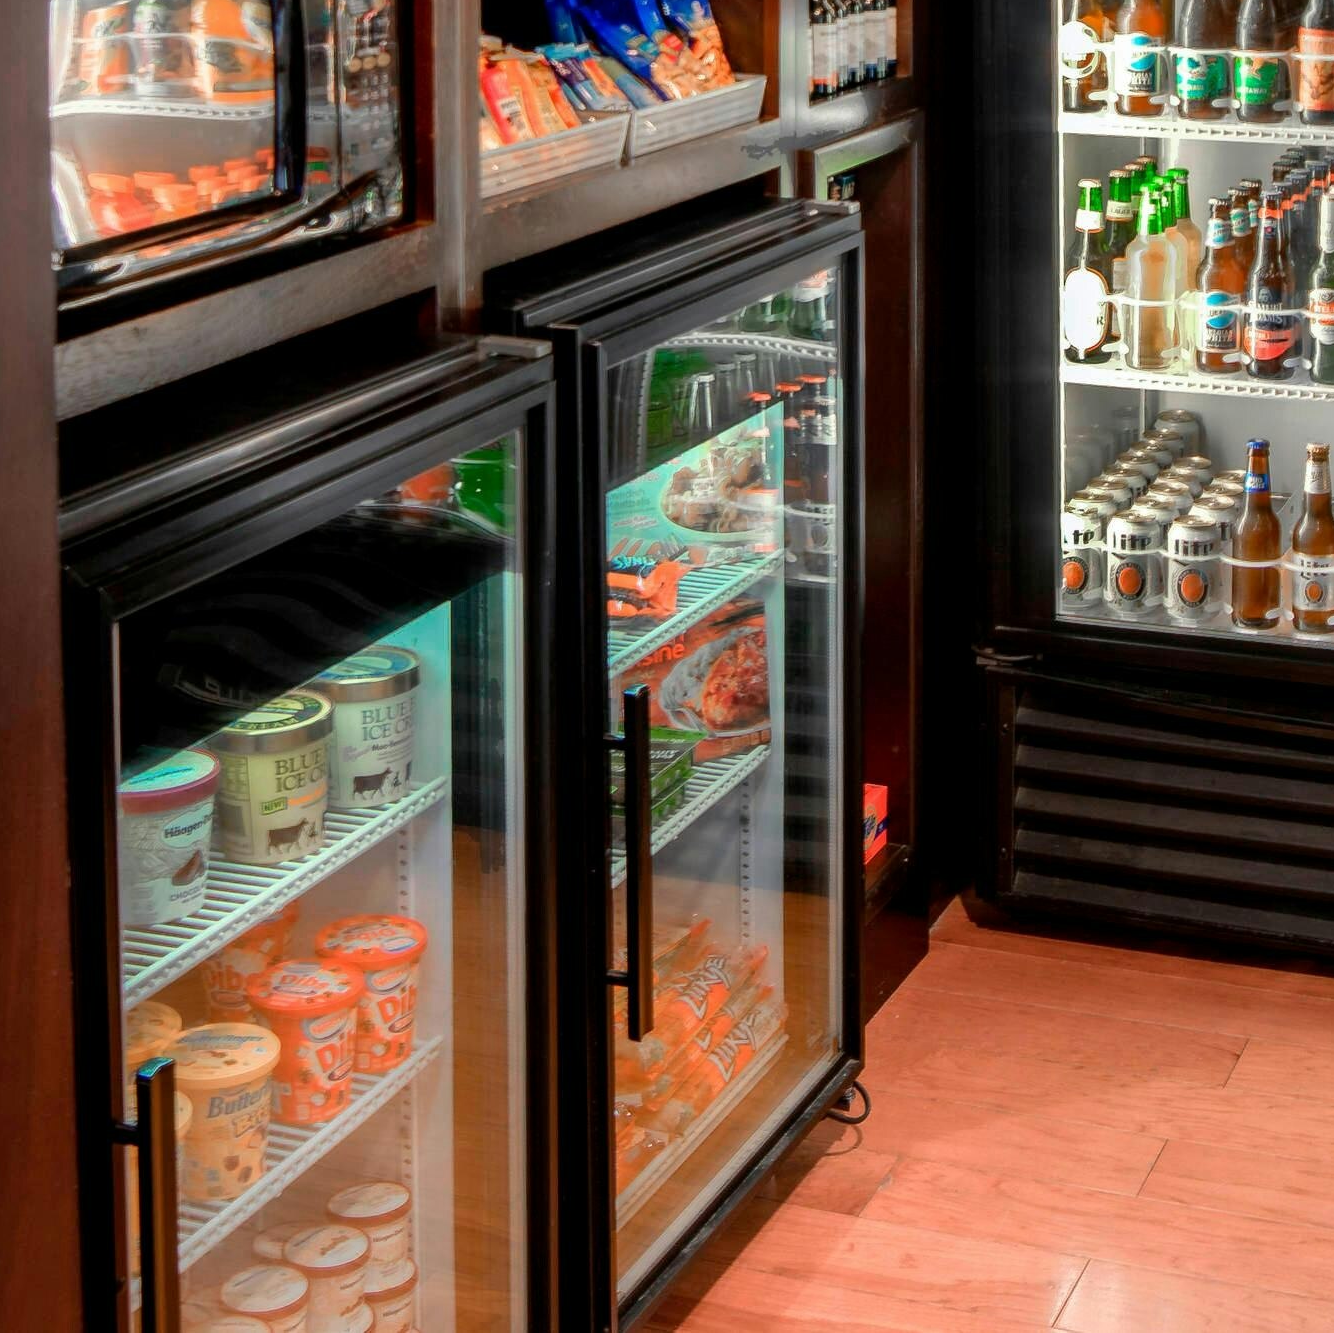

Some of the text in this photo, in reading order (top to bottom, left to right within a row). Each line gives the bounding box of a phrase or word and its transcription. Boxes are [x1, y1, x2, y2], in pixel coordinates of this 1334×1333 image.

[362, 720, 392, 742] ICE
[274, 746, 326, 777] BLUE
[275, 772, 307, 794] ICE
